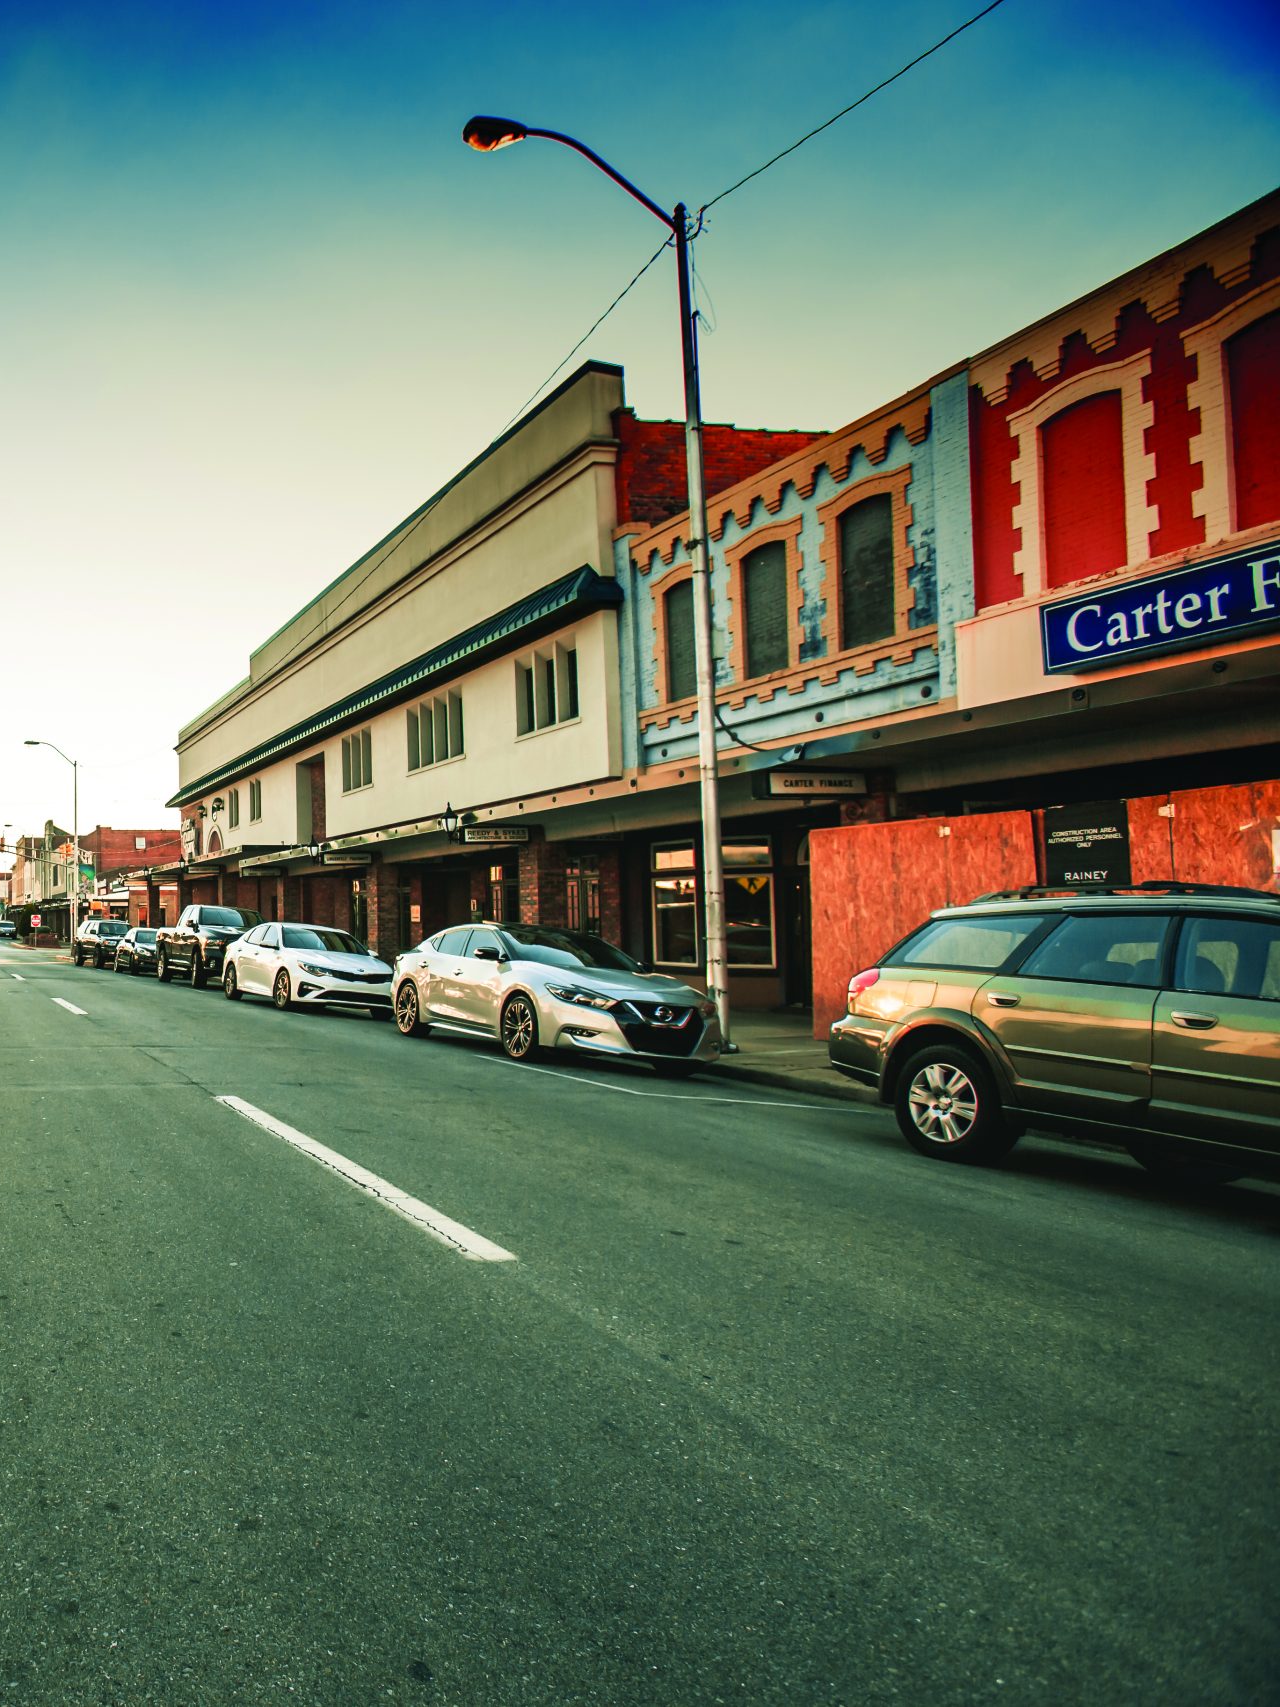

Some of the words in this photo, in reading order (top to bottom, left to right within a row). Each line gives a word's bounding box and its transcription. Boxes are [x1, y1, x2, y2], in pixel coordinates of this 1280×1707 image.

[1066, 583, 1229, 652] Carter
[784, 779, 815, 787] CARTER
[820, 779, 853, 787] FINANCE
[1052, 829, 1098, 837] CONSTRUCTION
[1064, 870, 1108, 880] RAINEY
